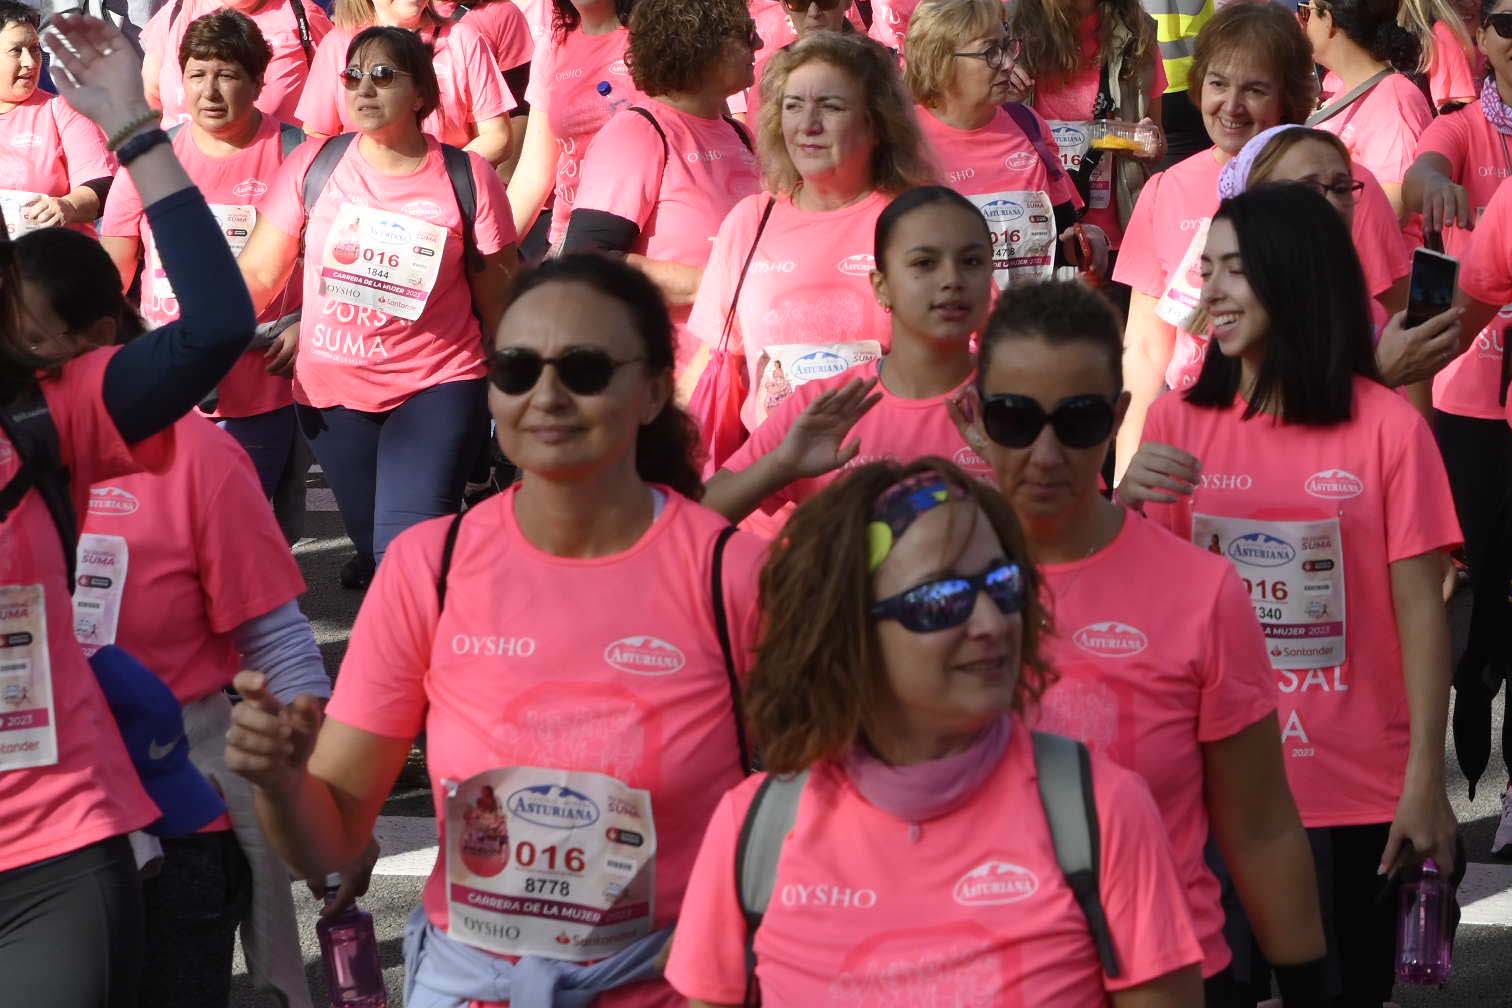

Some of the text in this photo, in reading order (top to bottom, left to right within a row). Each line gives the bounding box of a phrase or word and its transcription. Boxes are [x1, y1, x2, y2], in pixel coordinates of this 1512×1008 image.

[1061, 154, 1081, 166] 16
[983, 205, 1021, 218] ASTURIANA
[363, 248, 400, 268] 016
[367, 267, 389, 280] 1844
[332, 271, 363, 285] CARRERA
[363, 279, 373, 287] DE
[373, 281, 382, 289] LA
[382, 282, 405, 295] MUJER
[312, 324, 388, 358] SUMA
[1198, 473, 1252, 490] YSHO
[1309, 480, 1360, 494] ASTURIANA
[1232, 541, 1332, 561] ASTURIANA SUMA
[81, 555, 115, 566] SUMA
[0, 607, 28, 619] UMA
[1254, 606, 1282, 620] 340
[1272, 627, 1330, 635] MUJER 2023
[451, 634, 536, 657] OYSHO
[1078, 634, 1142, 653] ASTURIANA
[1283, 645, 1334, 657] Santander
[607, 645, 679, 669] ASTURIANA
[8, 714, 33, 726] 2023
[1292, 748, 1315, 757] 2023
[513, 797, 593, 821] ASTURIANA
[515, 841, 586, 873] 016
[525, 878, 570, 897] 8778
[781, 884, 877, 909] OYSHO
[961, 880, 1032, 898] ASTURIANA
[468, 894, 521, 911] CARRERA
[523, 903, 540, 914] DE
[543, 905, 560, 916] LA
[561, 908, 601, 922] MUJER
[464, 916, 521, 941] OYSHO
